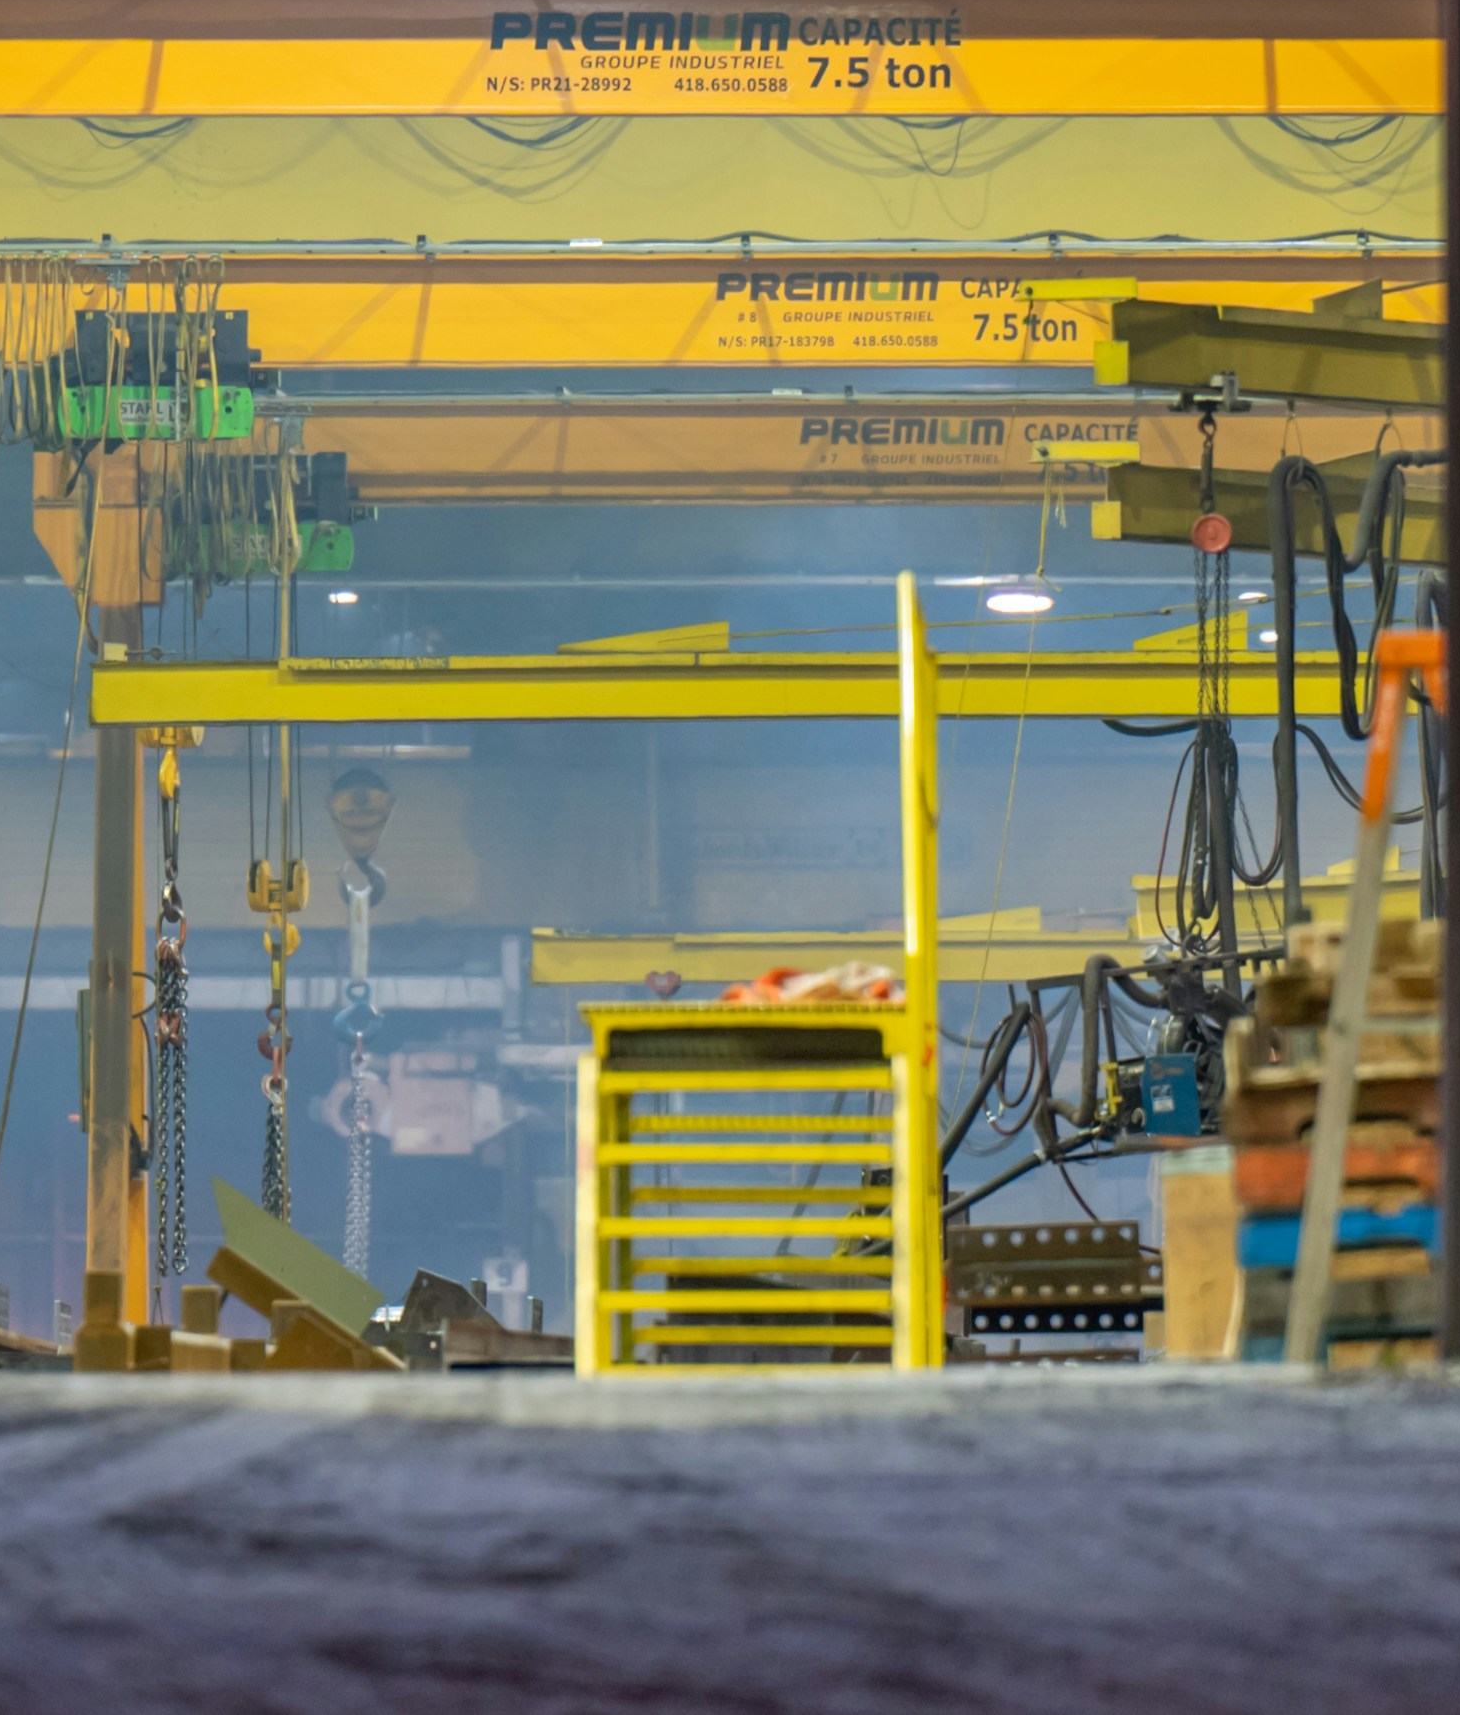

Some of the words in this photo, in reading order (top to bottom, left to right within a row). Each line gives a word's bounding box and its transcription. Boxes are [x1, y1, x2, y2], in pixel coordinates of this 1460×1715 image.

[490, 11, 791, 51] PREMIUM
[798, 8, 961, 46] CAPACITÉ
[580, 55, 661, 70] GROUPE
[669, 55, 785, 70] INDUSTRIEL
[807, 56, 869, 89] 7.5
[885, 57, 951, 89] ton
[486, 76, 525, 94] N/S:
[530, 77, 632, 93] PR21-28992
[674, 77, 789, 92] 418.650.0588
[716, 271, 940, 302] PREMIUM
[749, 312, 757, 323] 8
[783, 311, 842, 323] GROUPE
[848, 311, 934, 323] INDUSTRIEL
[973, 313, 1019, 341] 7.5
[1029, 313, 1078, 341] ton
[718, 336, 747, 349] N/S:
[853, 335, 939, 347] 418.650.0588
[799, 418, 1005, 445] PREMIUM
[861, 453, 916, 465] GROUPE
[921, 453, 1001, 465] INDUSTRIEL
